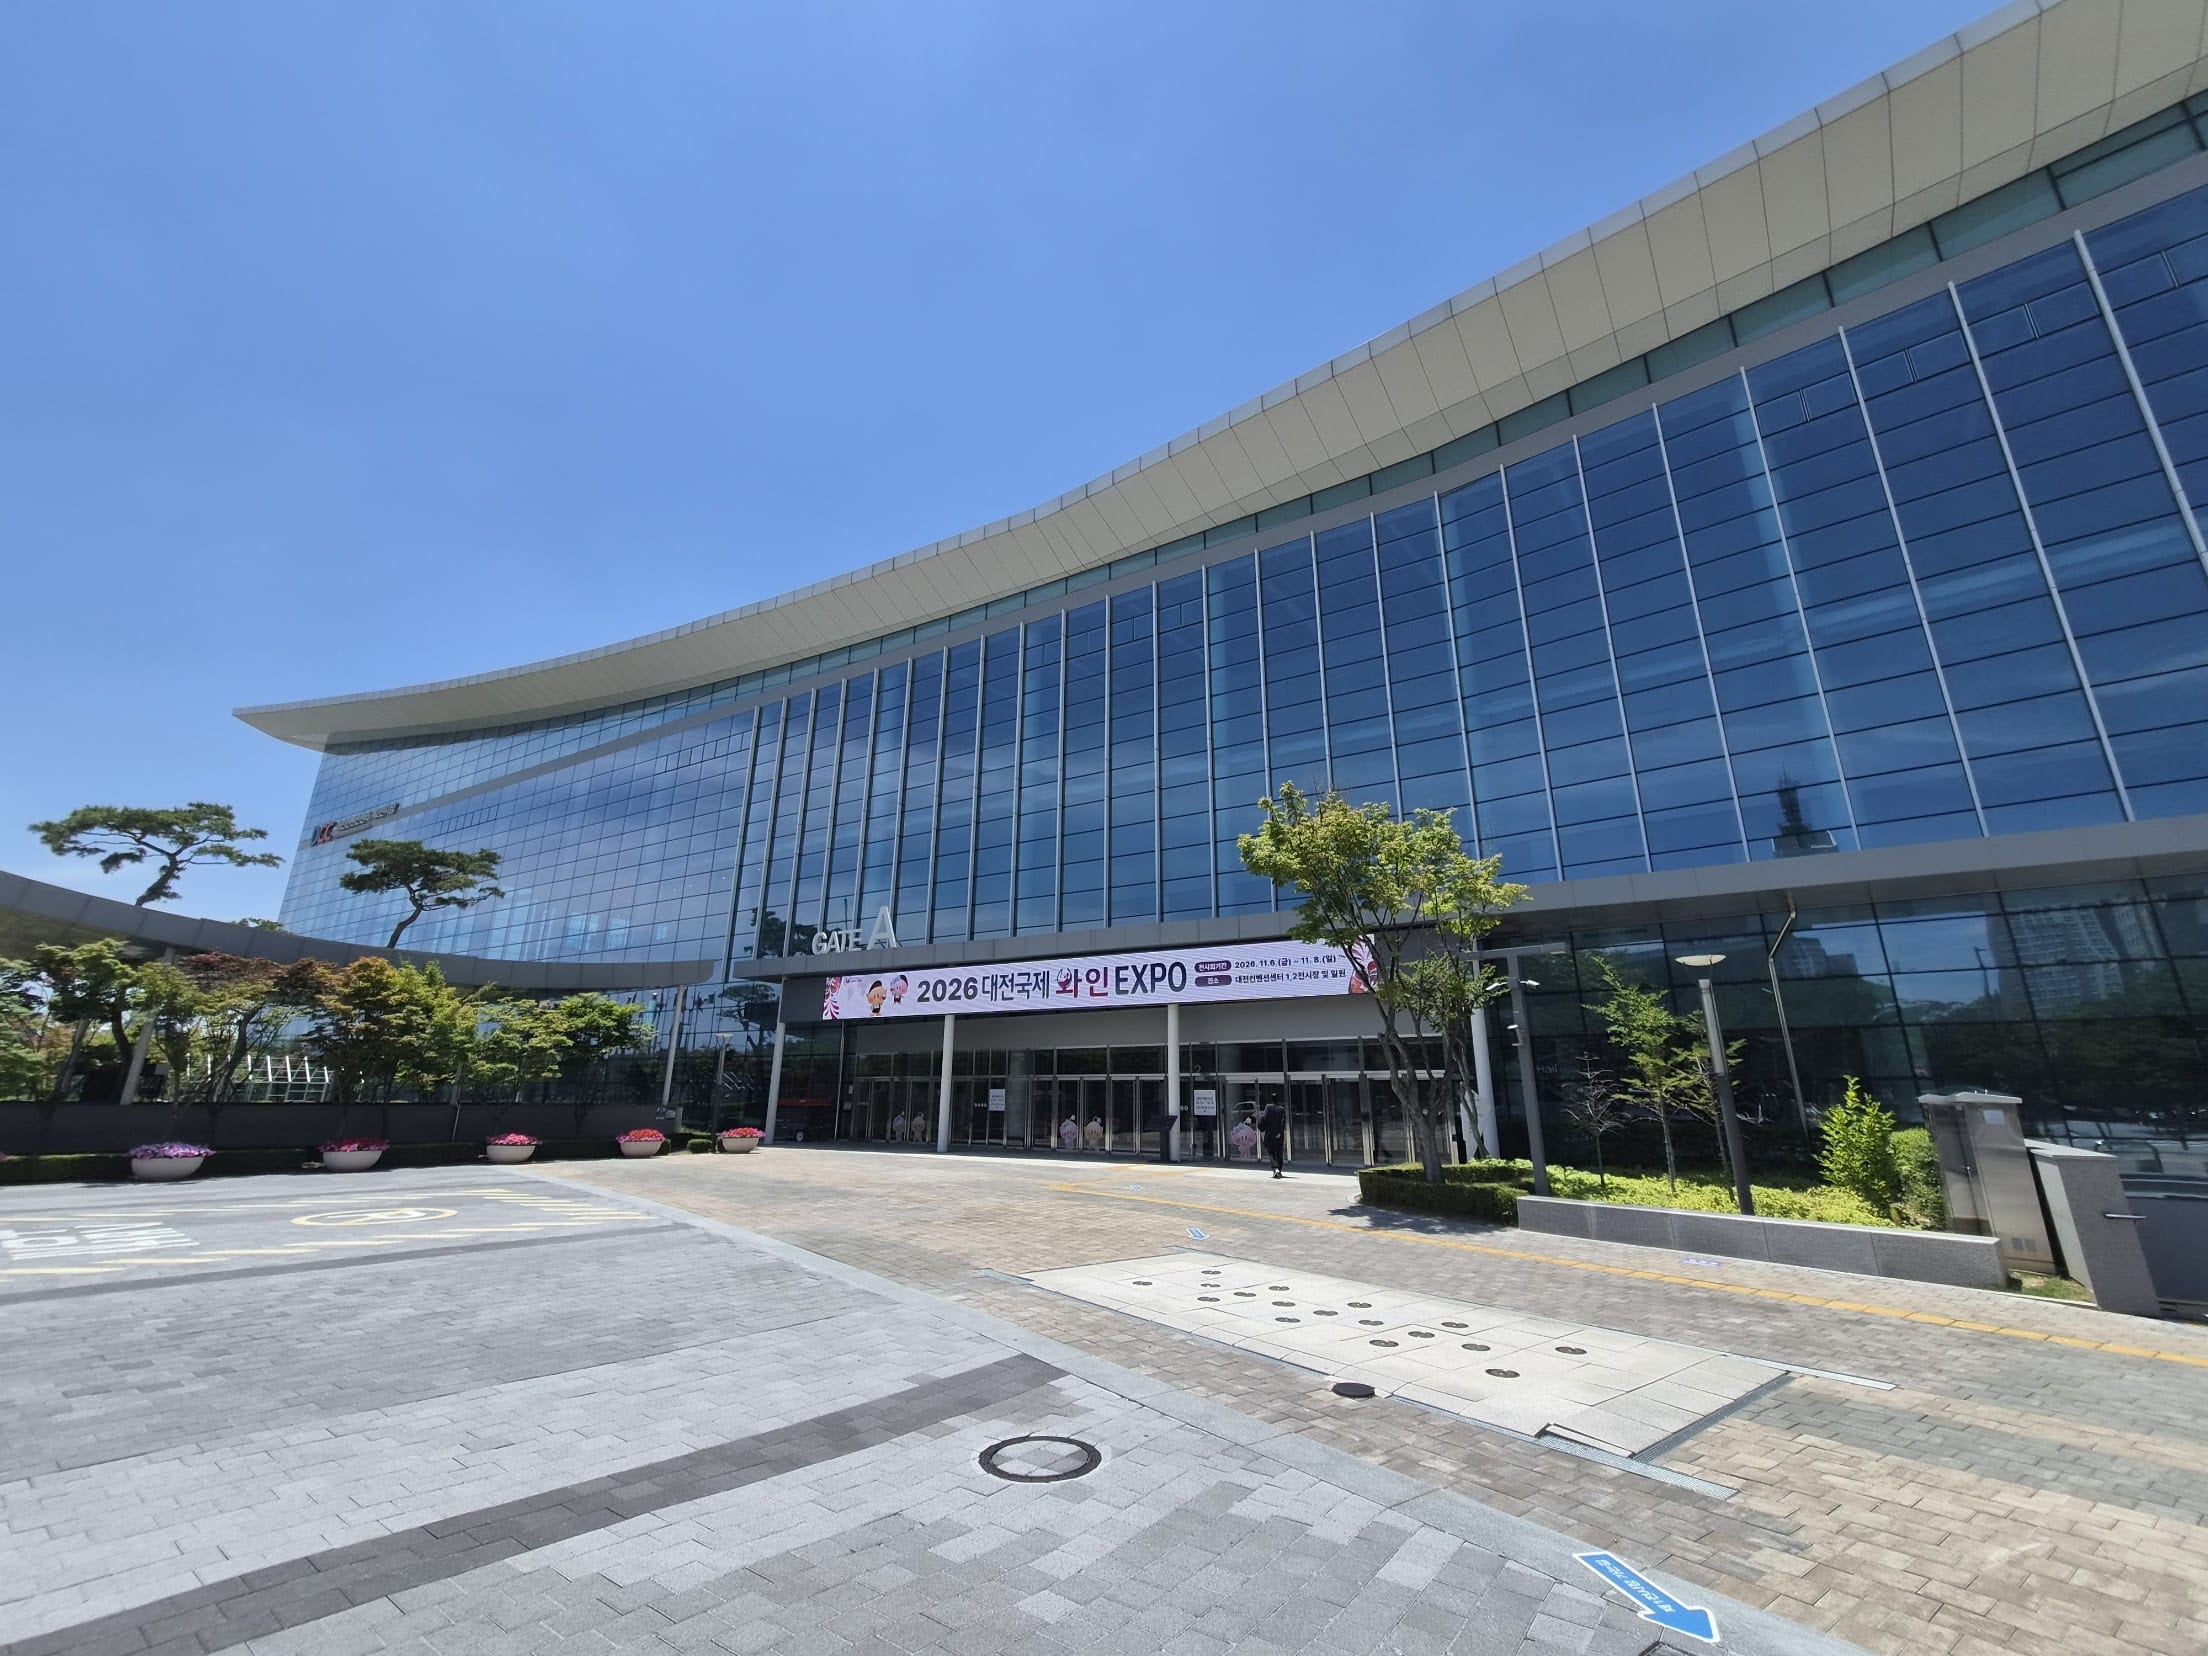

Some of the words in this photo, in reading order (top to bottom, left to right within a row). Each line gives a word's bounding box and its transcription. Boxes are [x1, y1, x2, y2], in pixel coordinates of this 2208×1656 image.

[811, 928, 863, 955] GATE
[866, 906, 897, 951] A
[917, 976, 978, 1002] 2026
[981, 970, 1050, 1002] 대전국제
[1114, 961, 1188, 995] EXPO
